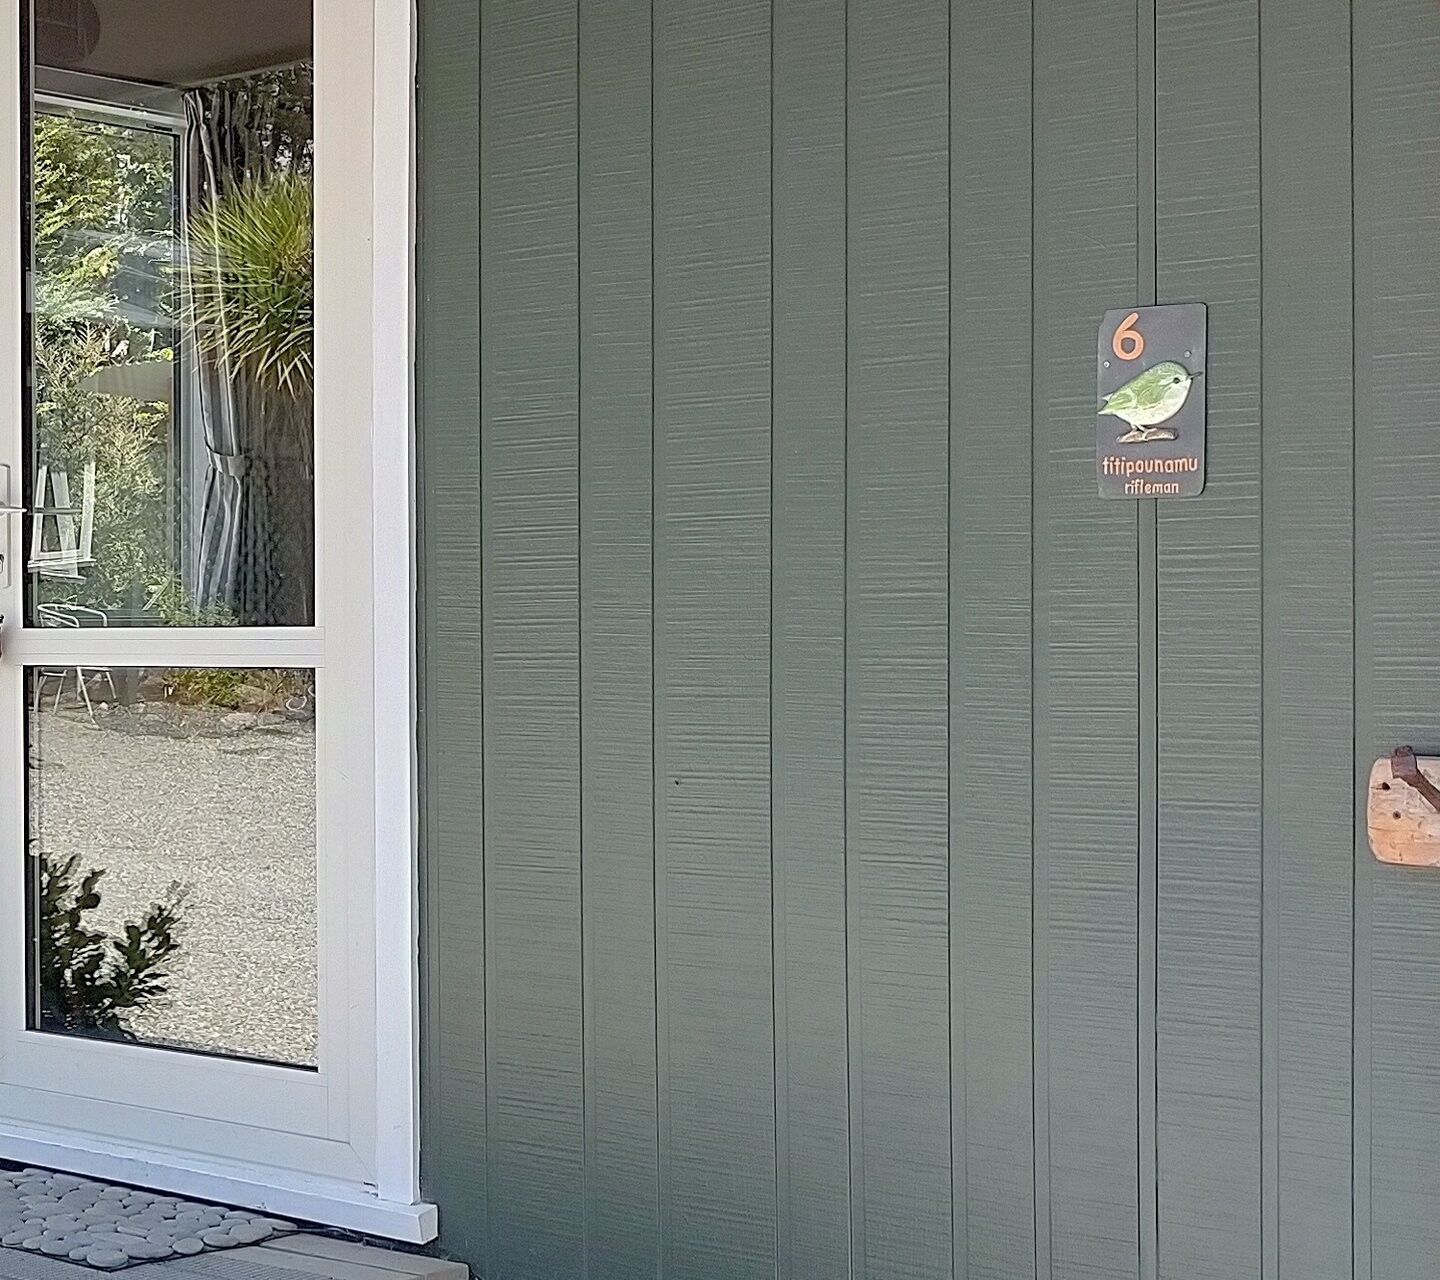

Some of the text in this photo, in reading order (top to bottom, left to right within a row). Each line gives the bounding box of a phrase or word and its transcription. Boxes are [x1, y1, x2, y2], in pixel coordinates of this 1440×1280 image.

[1112, 311, 1145, 361] 6
[1102, 456, 1198, 477] titipounamu
[1124, 479, 1179, 494] rifleman
